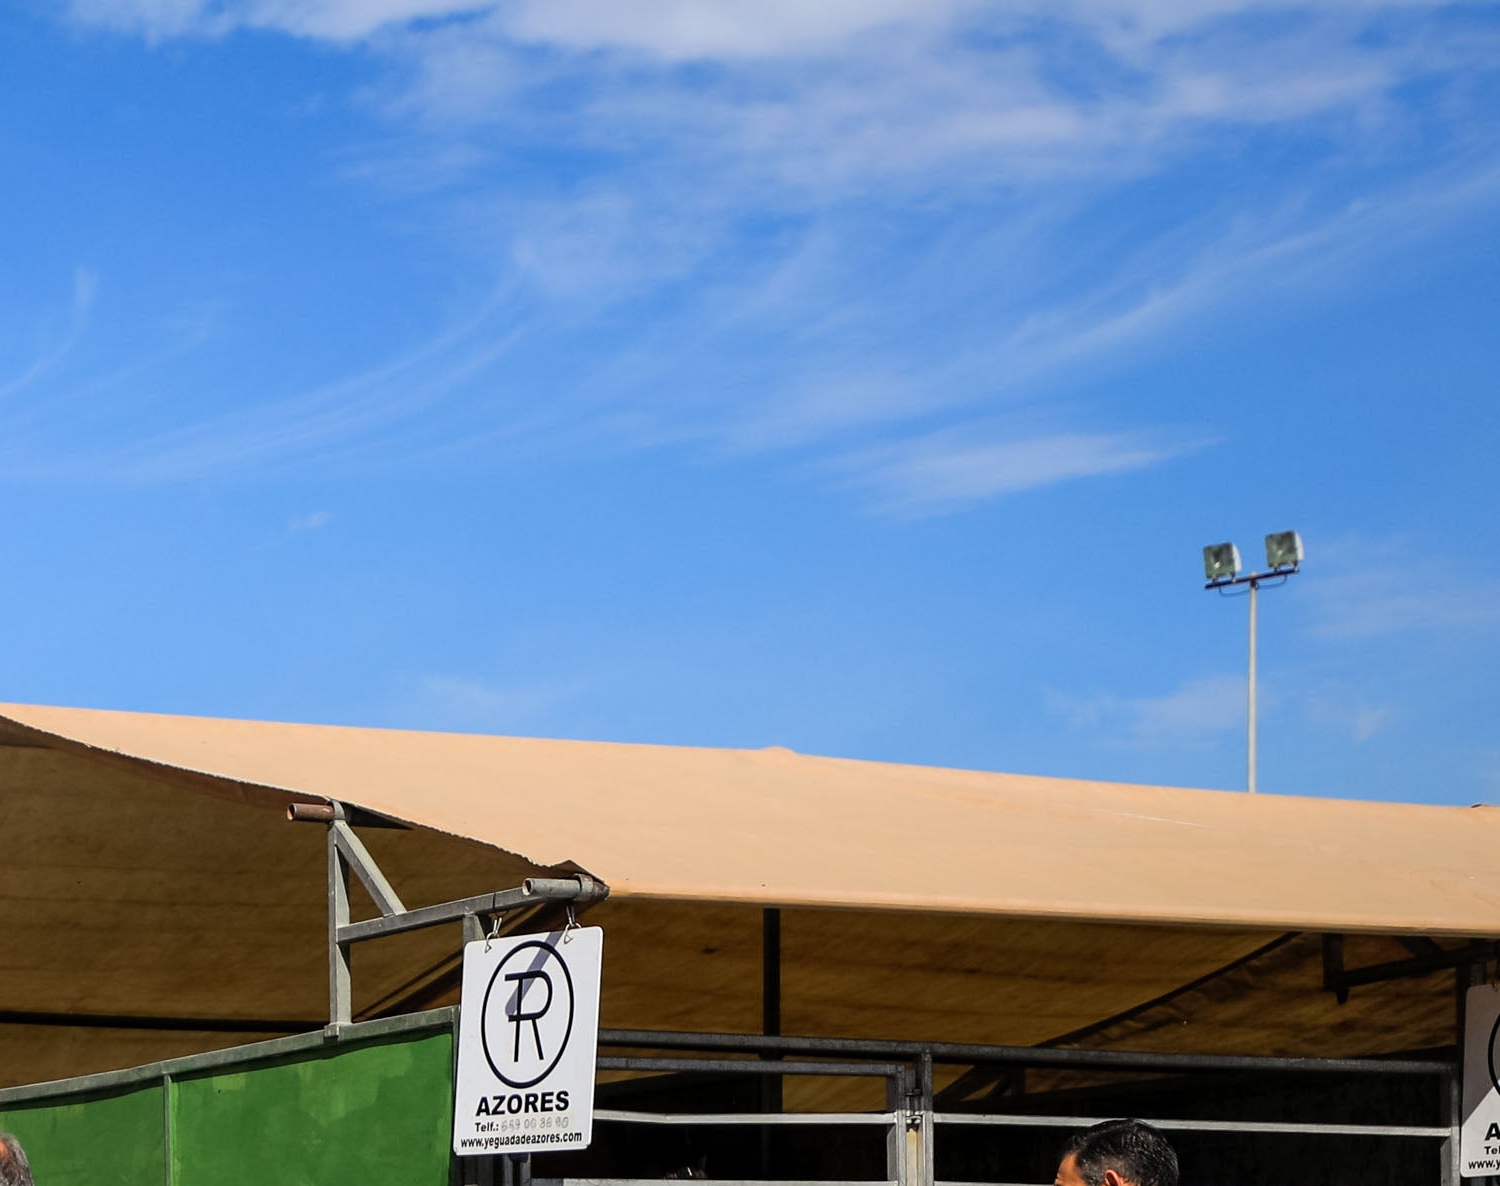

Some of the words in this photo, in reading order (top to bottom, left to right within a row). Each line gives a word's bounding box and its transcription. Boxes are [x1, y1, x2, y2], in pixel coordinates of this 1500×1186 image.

[475, 1090, 570, 1117] AZORES
[475, 1121, 499, 1133] Telf.:
[460, 1131, 582, 1150] www.yeguadadeazores.com
